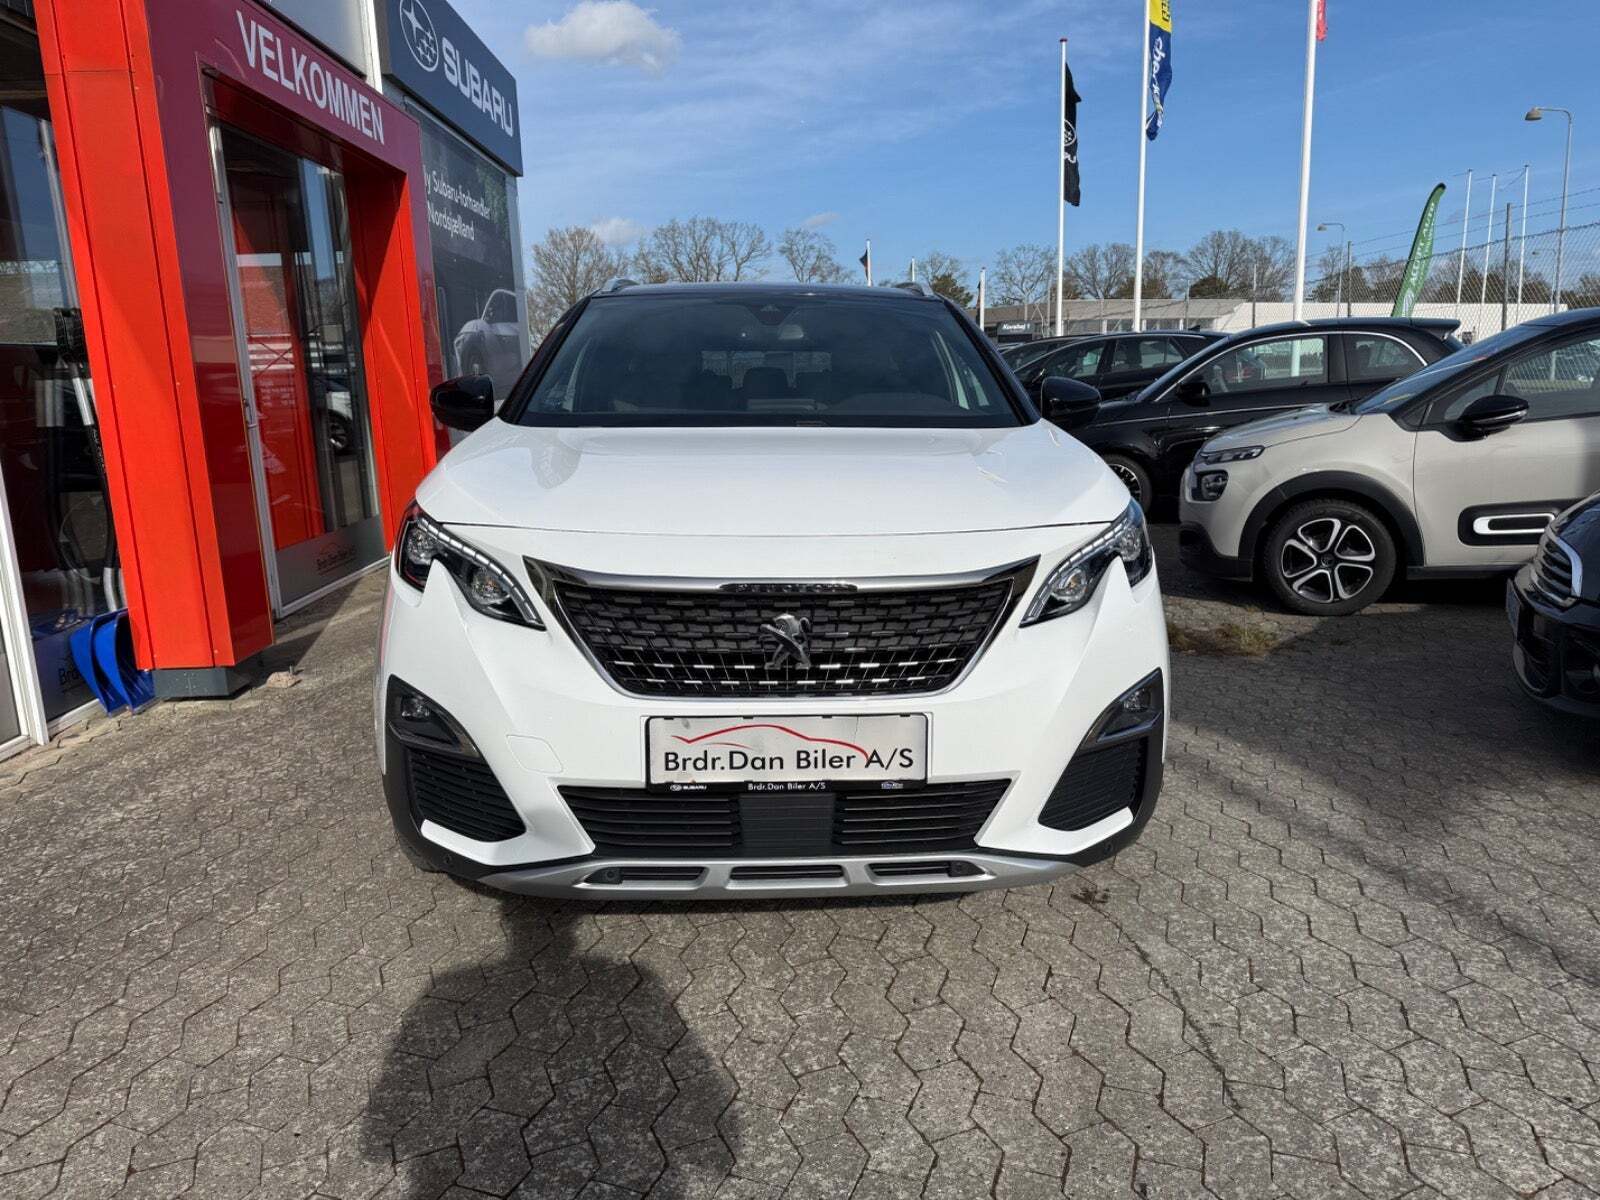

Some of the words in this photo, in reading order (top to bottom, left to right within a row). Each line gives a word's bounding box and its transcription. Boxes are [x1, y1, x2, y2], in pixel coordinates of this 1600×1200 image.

[236, 9, 385, 145] VELKOMMEN
[441, 36, 514, 138] SUBARU
[787, 782, 806, 790] Biler
[808, 782, 827, 790] A/S
[796, 749, 856, 770] Biler
[864, 748, 914, 770] A/S
